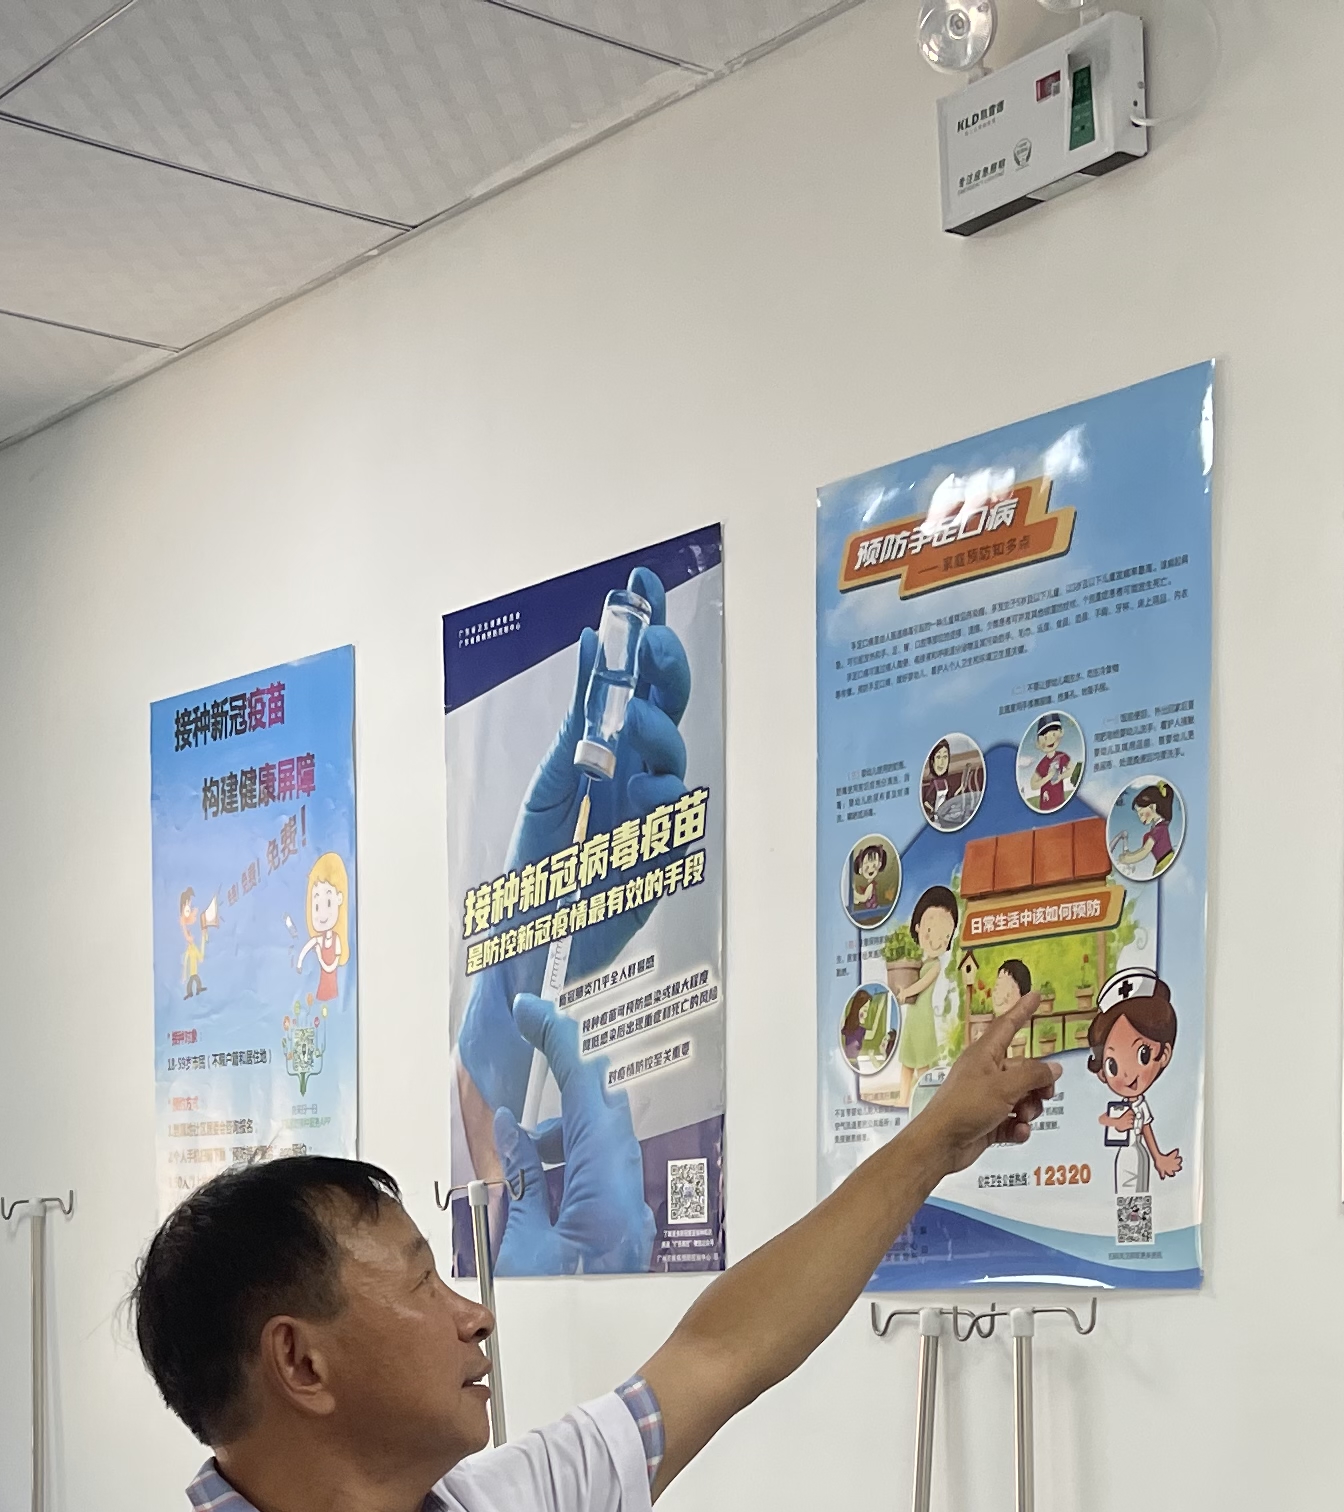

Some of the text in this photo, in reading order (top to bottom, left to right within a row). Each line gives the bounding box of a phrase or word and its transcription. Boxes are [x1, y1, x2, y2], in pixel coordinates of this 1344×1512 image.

[174, 680, 286, 752] 接种新冠疫苗
[201, 751, 317, 821] 构建健康屏障
[462, 789, 708, 938] 接种新冠病毒疫苗
[465, 849, 707, 977] 是防控新冠疫情最有效的手段
[971, 898, 1101, 935] 日常生活中该如何预防
[1034, 1163, 1092, 1187] 12320
